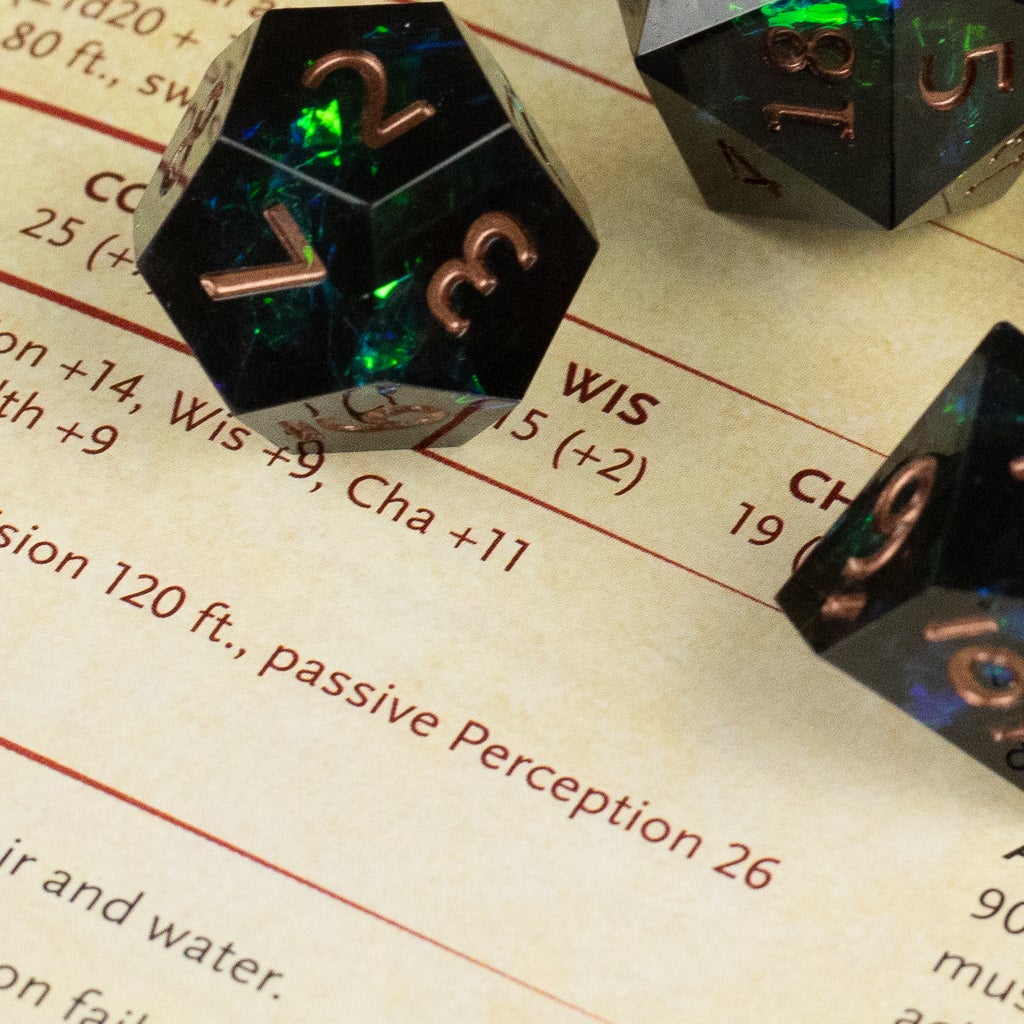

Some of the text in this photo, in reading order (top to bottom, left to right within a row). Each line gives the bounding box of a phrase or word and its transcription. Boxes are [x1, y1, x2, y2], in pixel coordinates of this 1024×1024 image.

[1, 21, 63, 59] 80
[18, 207, 85, 247] 25
[562, 360, 662, 428] WIS
[56, 420, 119, 455] +9
[60, 358, 146, 415] +14,
[169, 389, 252, 452] Wis
[347, 473, 437, 536] Cha
[449, 526, 531, 573] +11
[551, 428, 648, 497] (+2)
[729, 501, 785, 546] 19
[105, 560, 188, 619] 120
[190, 601, 248, 659] ft.,
[257, 642, 442, 740] passive
[449, 719, 705, 863] Perception
[712, 841, 783, 893] 26
[42, 868, 146, 926] and
[147, 913, 284, 1001] water.
